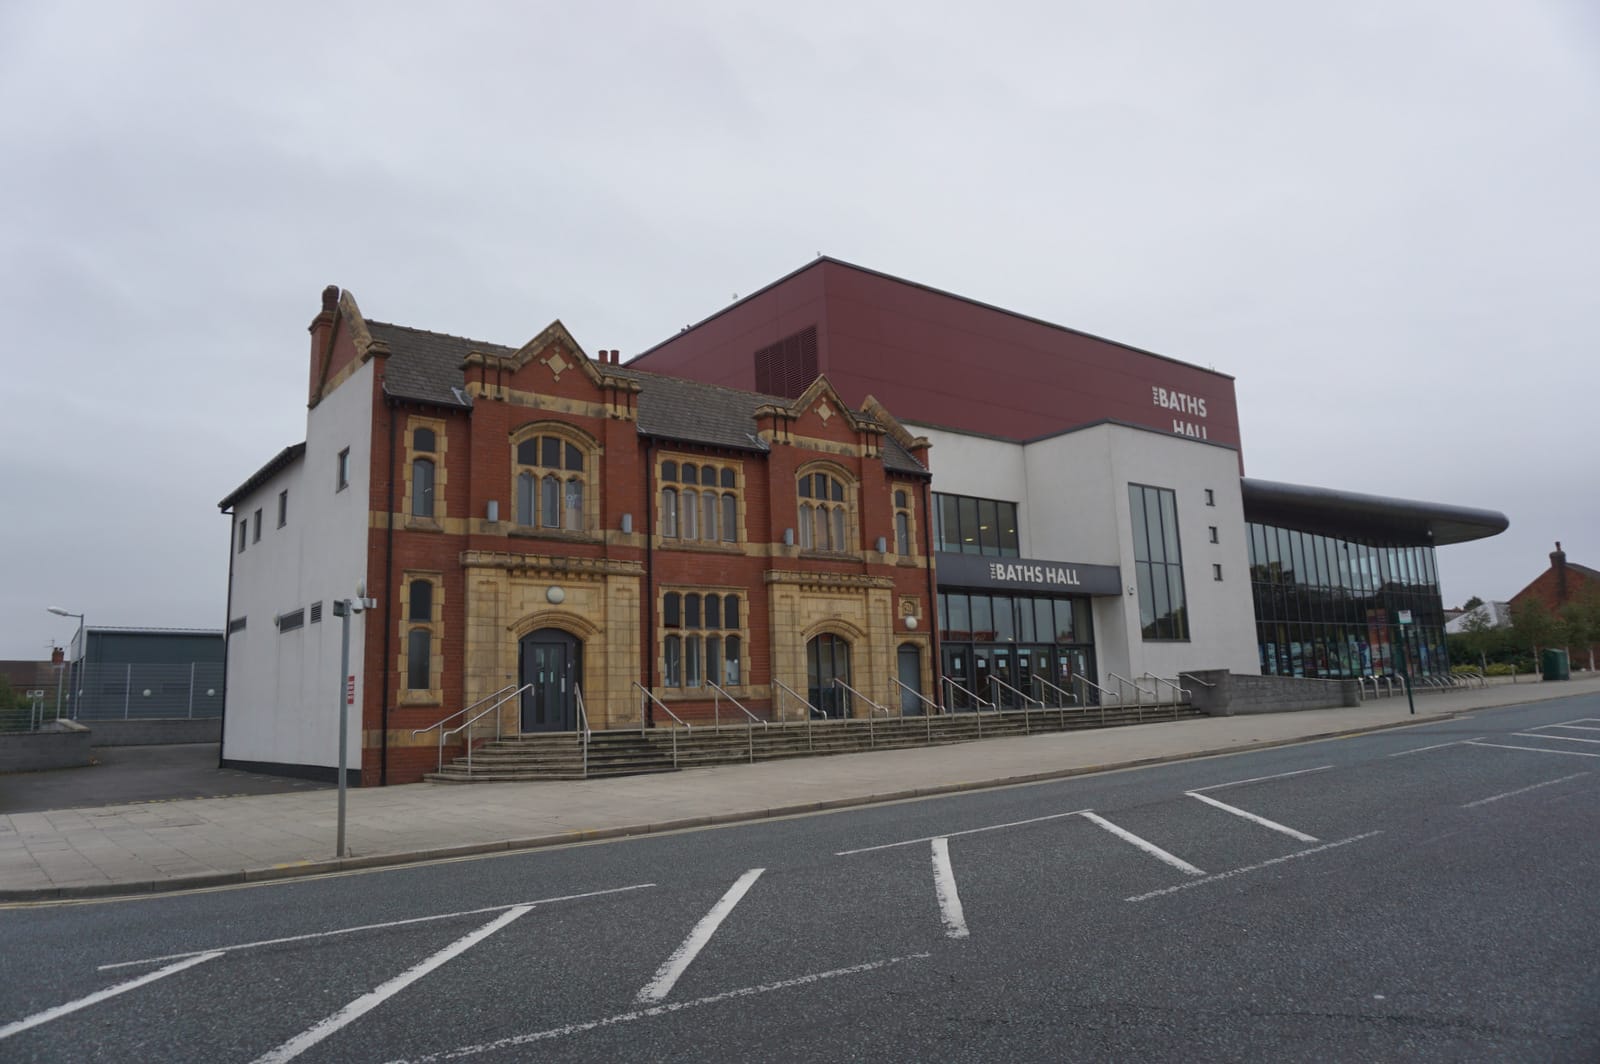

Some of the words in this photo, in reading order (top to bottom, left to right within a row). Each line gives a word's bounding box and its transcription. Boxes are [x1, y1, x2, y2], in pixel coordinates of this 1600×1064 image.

[1159, 388, 1207, 418] BATHS
[996, 563, 1043, 583] BATHS
[1046, 567, 1080, 585] HALL
